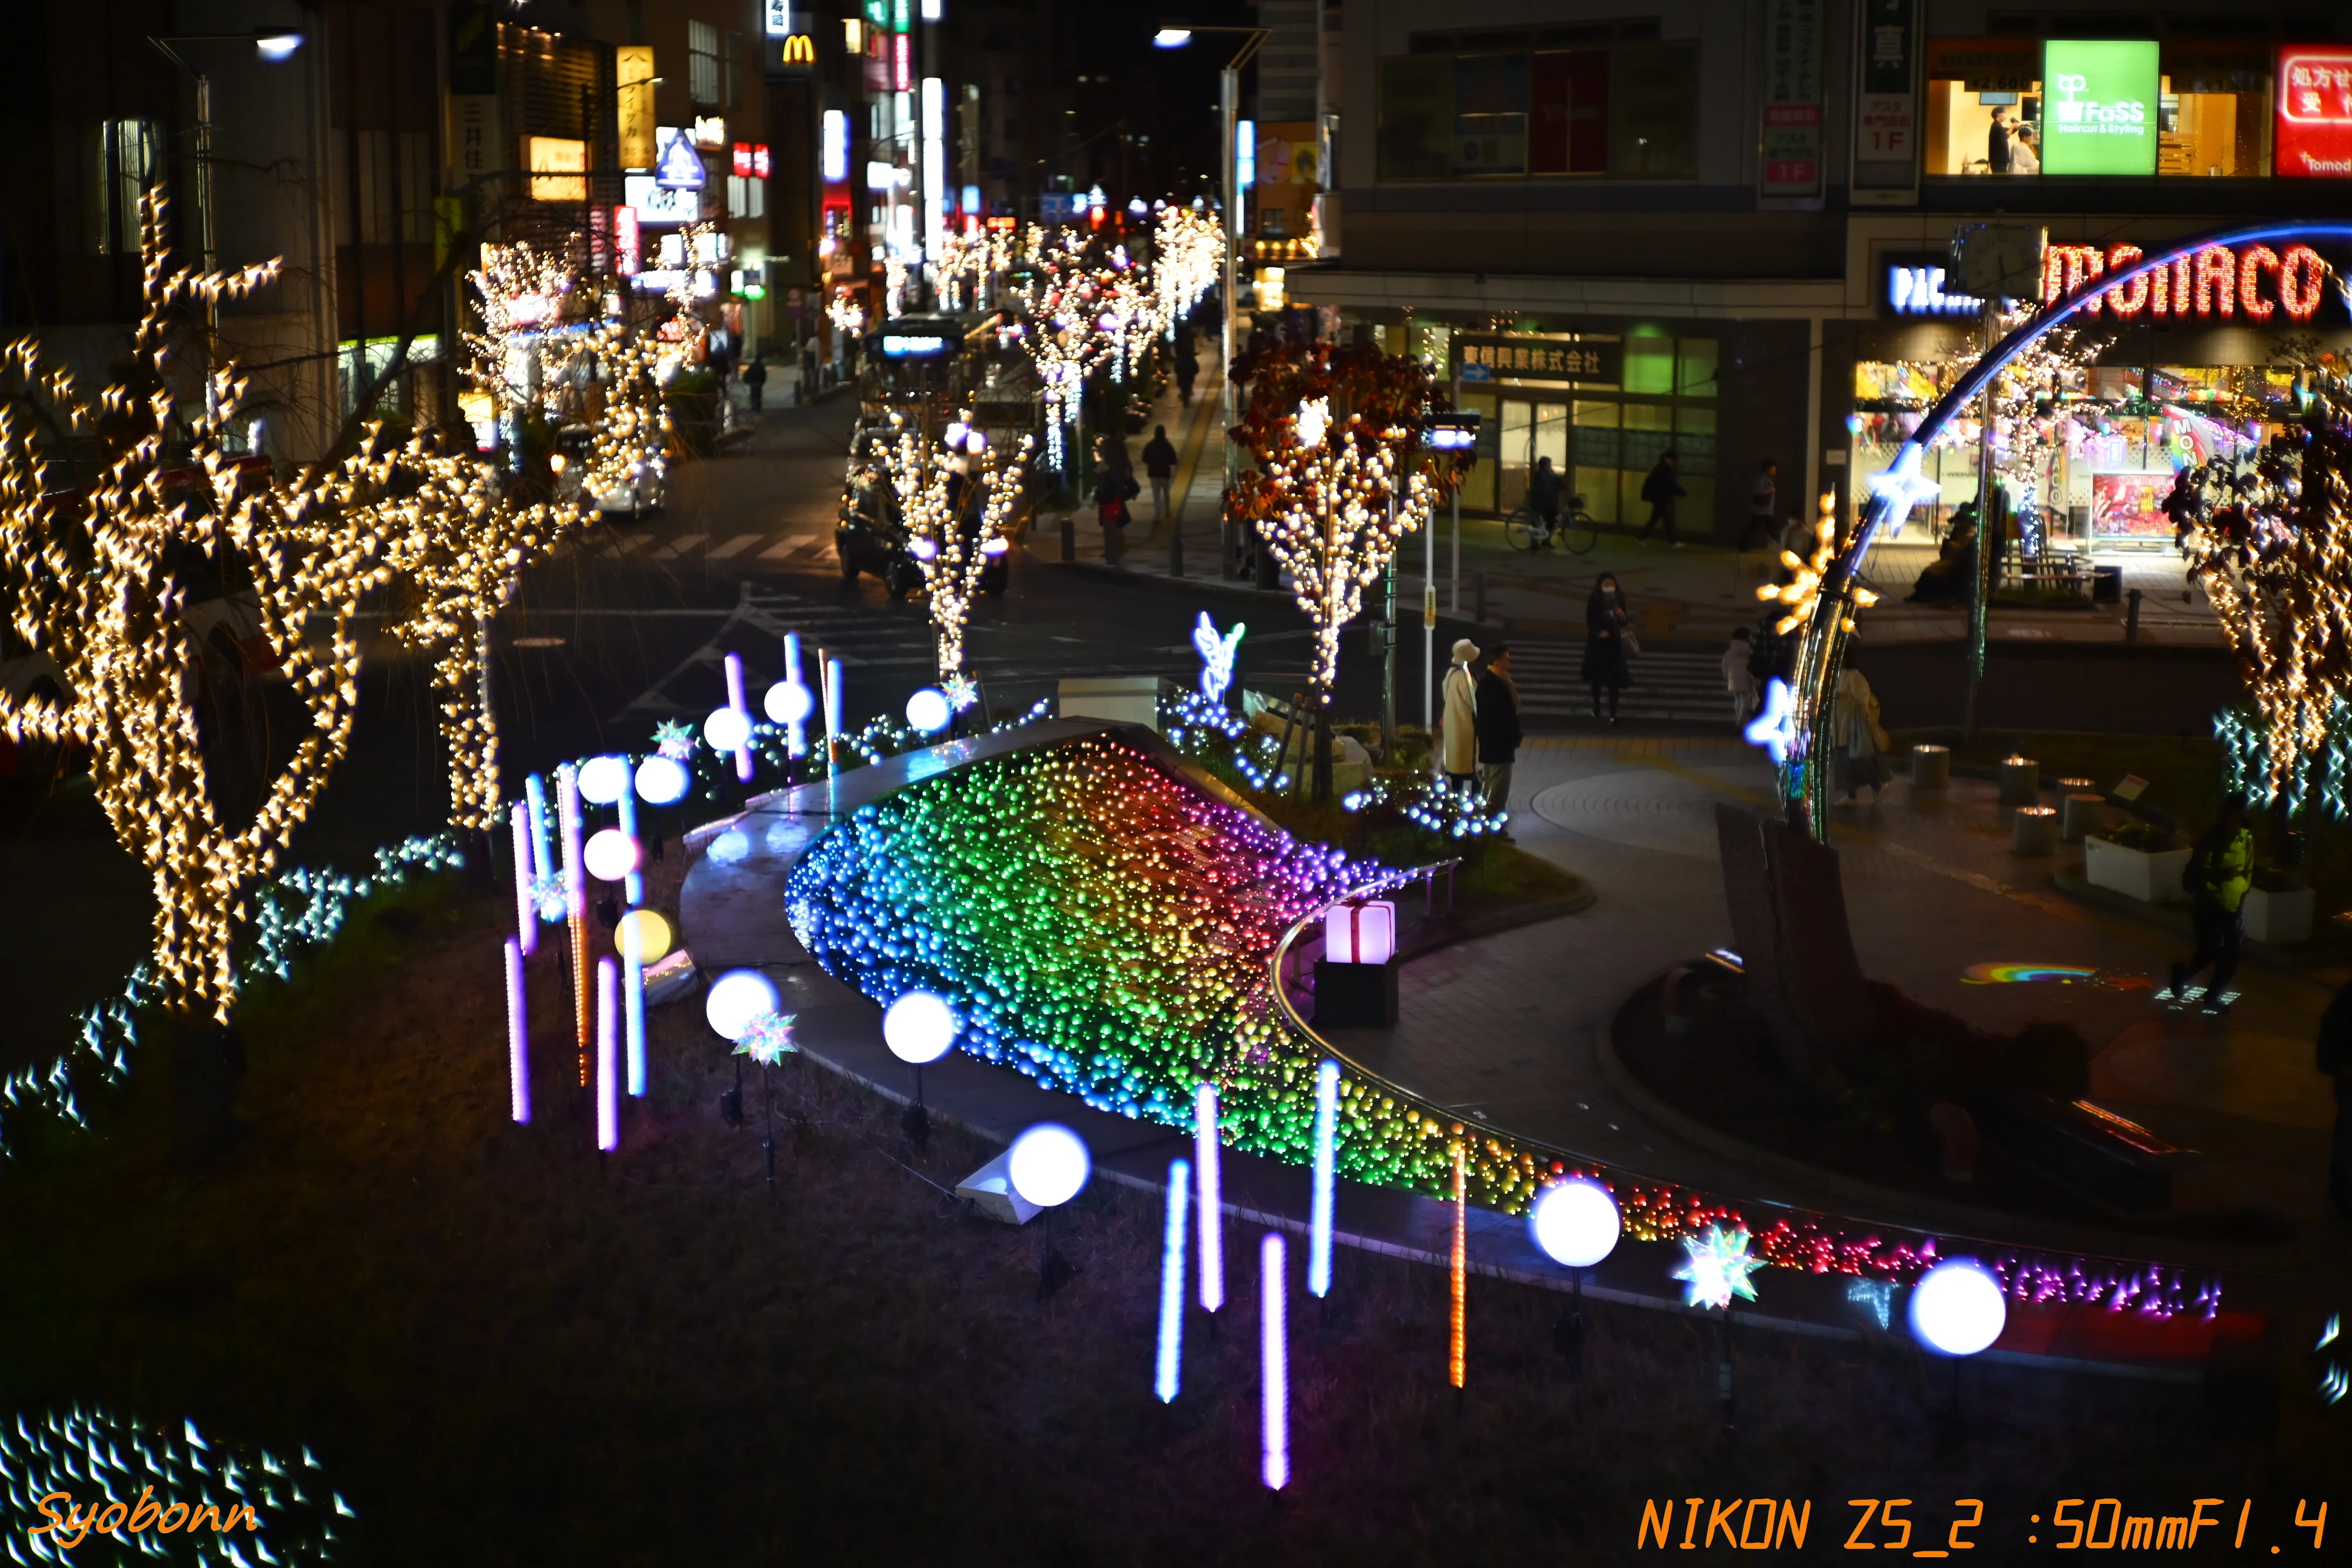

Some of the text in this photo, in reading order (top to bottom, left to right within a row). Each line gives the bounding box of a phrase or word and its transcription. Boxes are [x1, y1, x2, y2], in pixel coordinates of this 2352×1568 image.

[1873, 0, 1905, 69] 真
[1871, 101, 1902, 112] アスタ
[2086, 102, 2144, 122] FaSS
[2059, 124, 2145, 135] Haircut & Styling
[1872, 132, 1905, 150] 1F
[1779, 163, 1806, 180] 1F
[2173, 417, 2199, 467] MON
